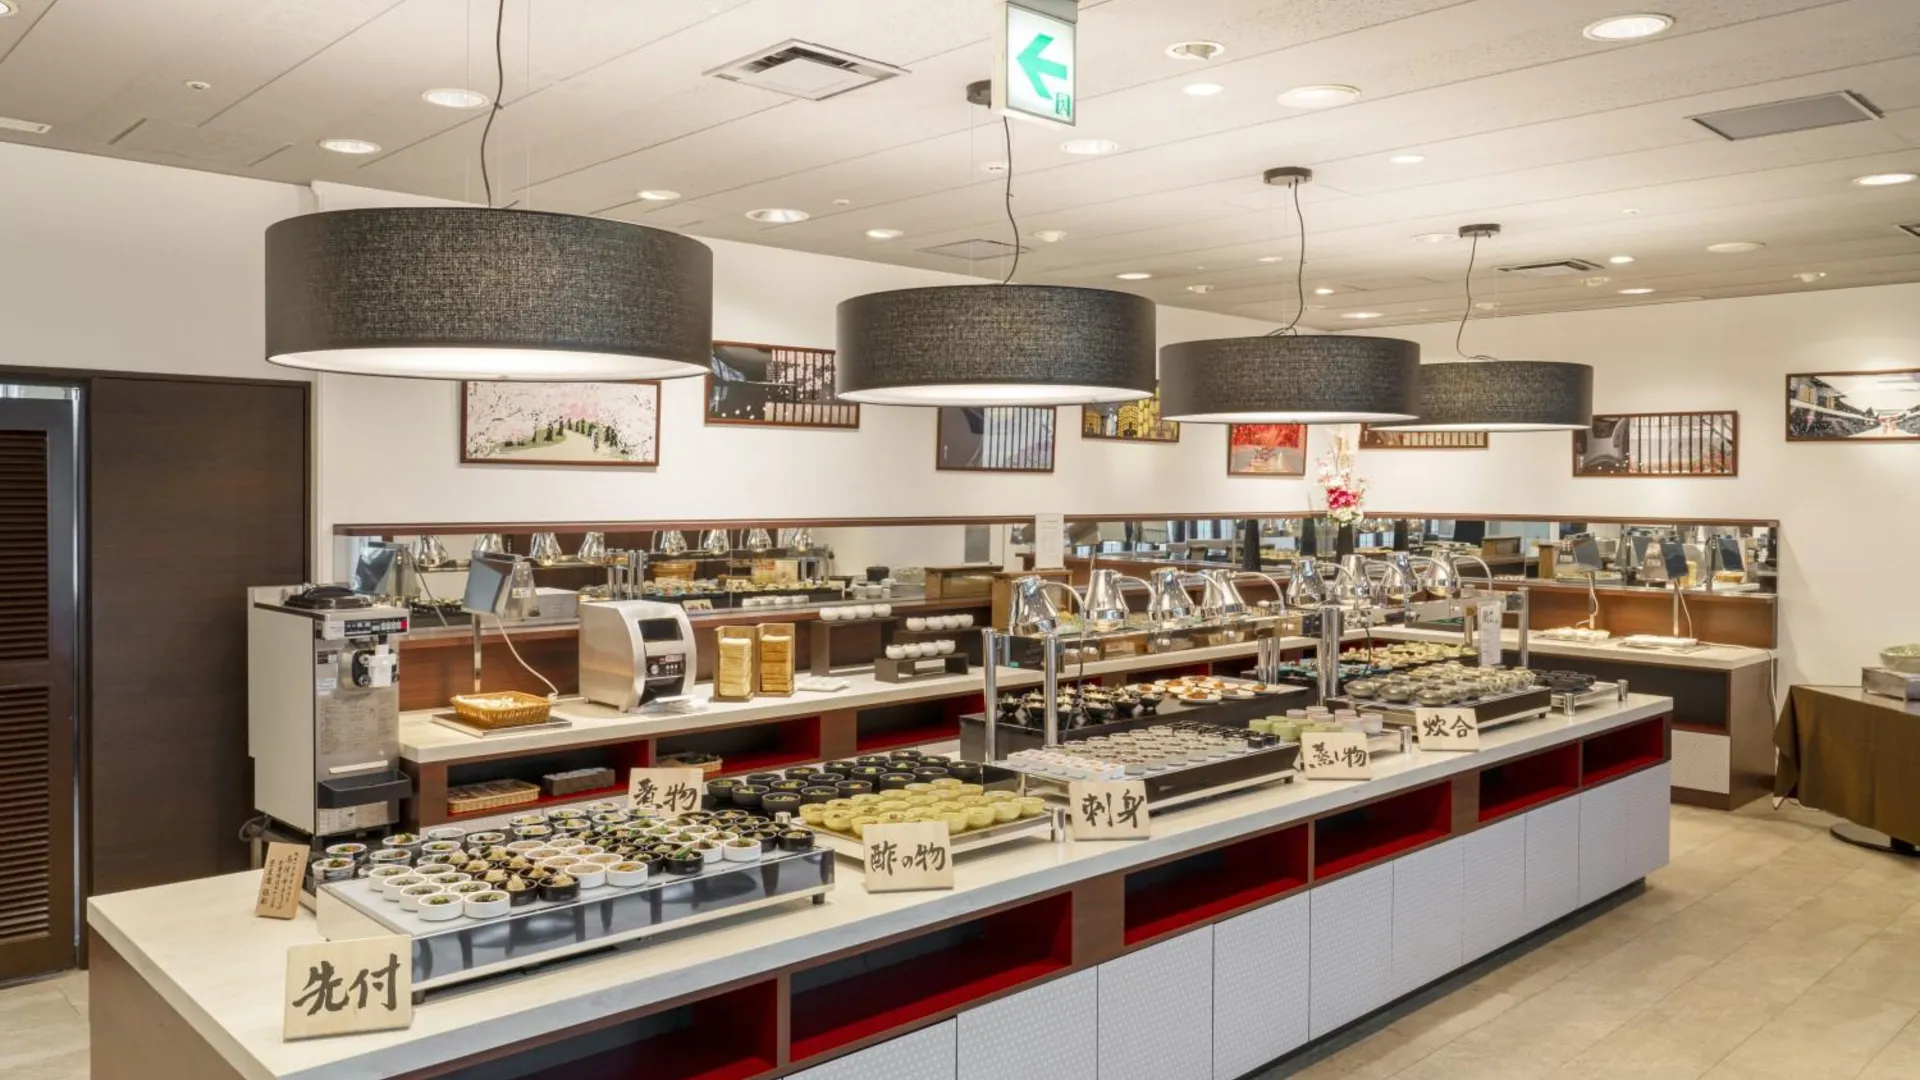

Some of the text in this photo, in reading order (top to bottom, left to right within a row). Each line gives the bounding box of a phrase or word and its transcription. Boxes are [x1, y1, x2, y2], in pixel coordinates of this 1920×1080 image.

[1422, 714, 1475, 738] 炊合
[633, 777, 697, 812] 煮物
[1082, 788, 1145, 829] 刺身
[870, 840, 945, 876] 酢の物
[292, 953, 401, 1016] 先付
